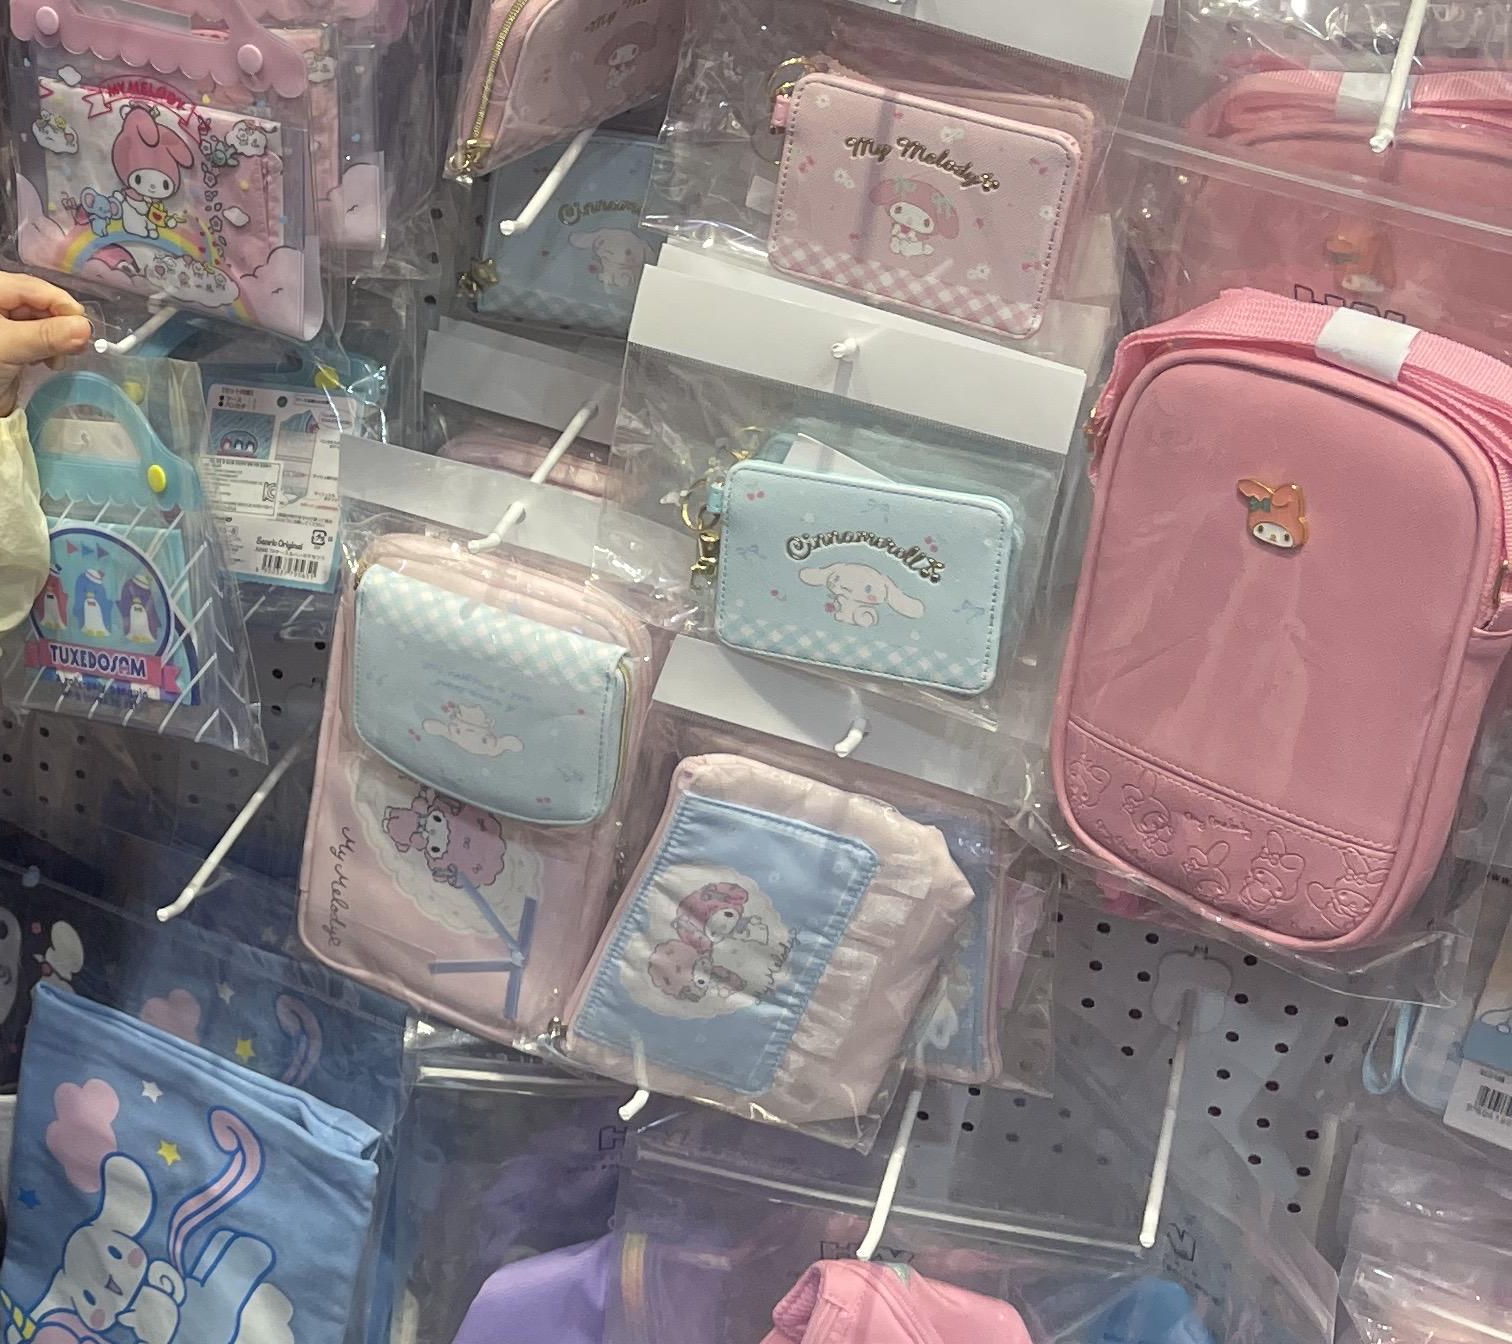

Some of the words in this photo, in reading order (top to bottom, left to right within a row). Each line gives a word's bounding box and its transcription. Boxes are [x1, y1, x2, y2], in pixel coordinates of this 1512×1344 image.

[844, 136, 892, 163] My
[896, 136, 983, 188] Melody
[786, 530, 929, 571] Cinnamoroll
[50, 644, 147, 677] TUXEDOSAM
[330, 826, 356, 862] My
[322, 864, 349, 944] Melody
